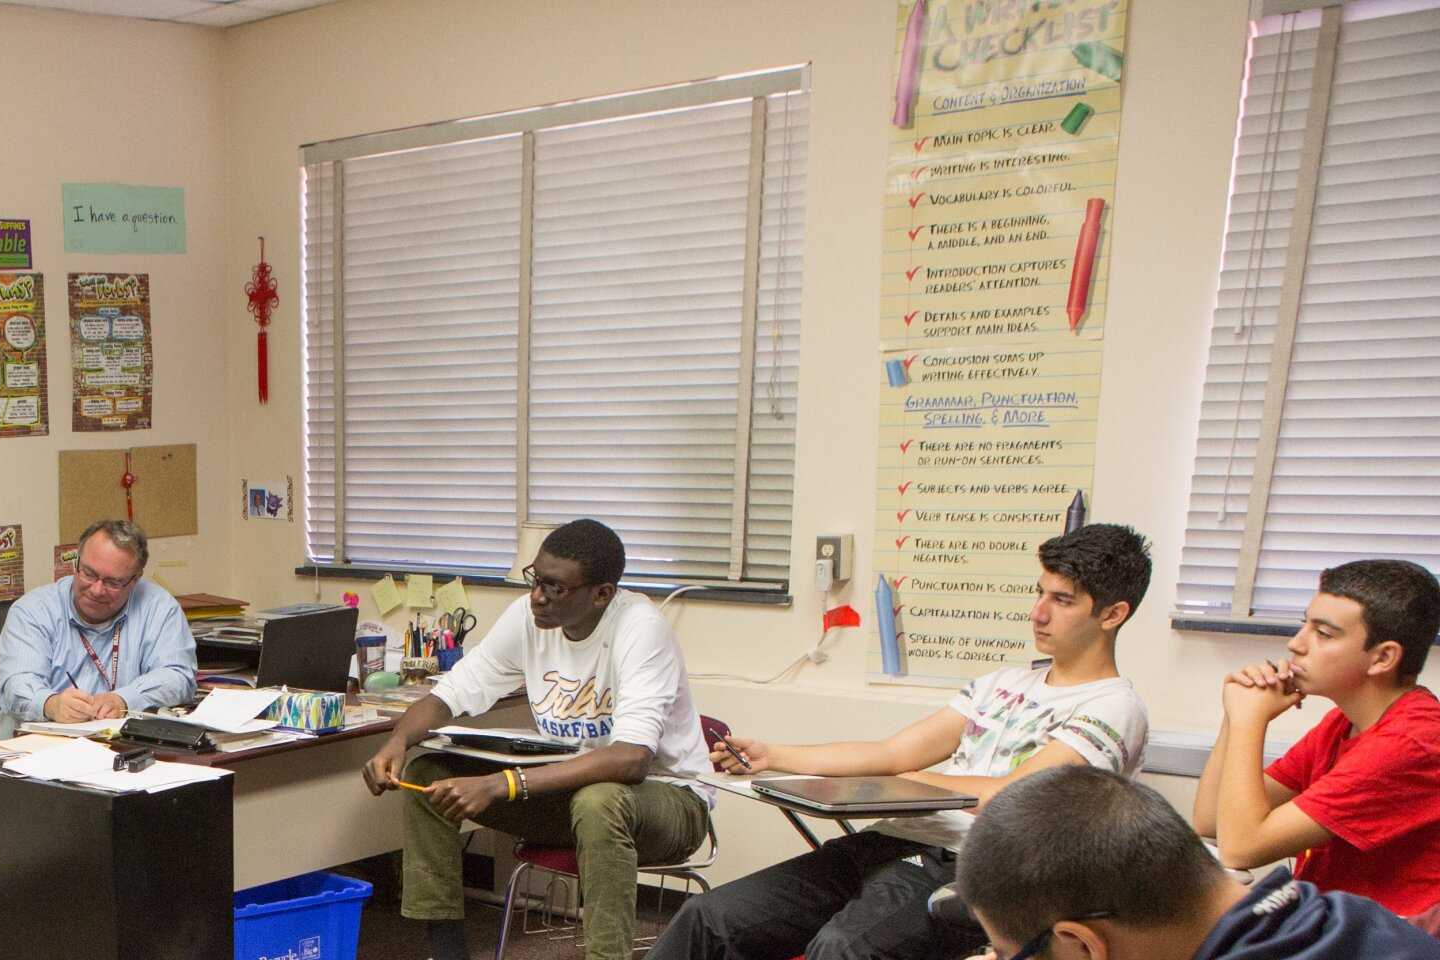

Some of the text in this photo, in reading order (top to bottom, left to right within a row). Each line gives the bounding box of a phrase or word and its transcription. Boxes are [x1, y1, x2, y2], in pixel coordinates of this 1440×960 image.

[931, 3, 1118, 72] CHECKLIST
[932, 92, 987, 112] CONTENT
[1000, 76, 1088, 102] ORGANIZATION
[933, 122, 1057, 149] MAIN TOPIC IS CLEAR.
[930, 153, 1071, 178] WRITING IS INTERESTING.
[929, 182, 1078, 206] VOCABULARY IS COLORFUL.
[0, 221, 26, 231] SUFFIXES
[73, 205, 179, 233] I have a question.
[928, 222, 965, 236] THERE
[968, 221, 978, 232] IS
[981, 220, 989, 231] A
[926, 259, 1067, 280] INTRODUCTION CAPTURES
[925, 277, 1042, 295] READERS' ATTENTION.
[905, 394, 977, 410] GRAMMAR,
[990, 409, 1000, 426] &
[1002, 410, 1047, 424] MORE
[916, 482, 1071, 495] SUBJECTS AND VERBS AGREE.
[910, 578, 984, 593] PUNCTUATION
[986, 582, 997, 592] IS
[909, 632, 1026, 650] SPELLING OF UNKNOWN
[907, 648, 1008, 663] WORDS IS CORRECT.
